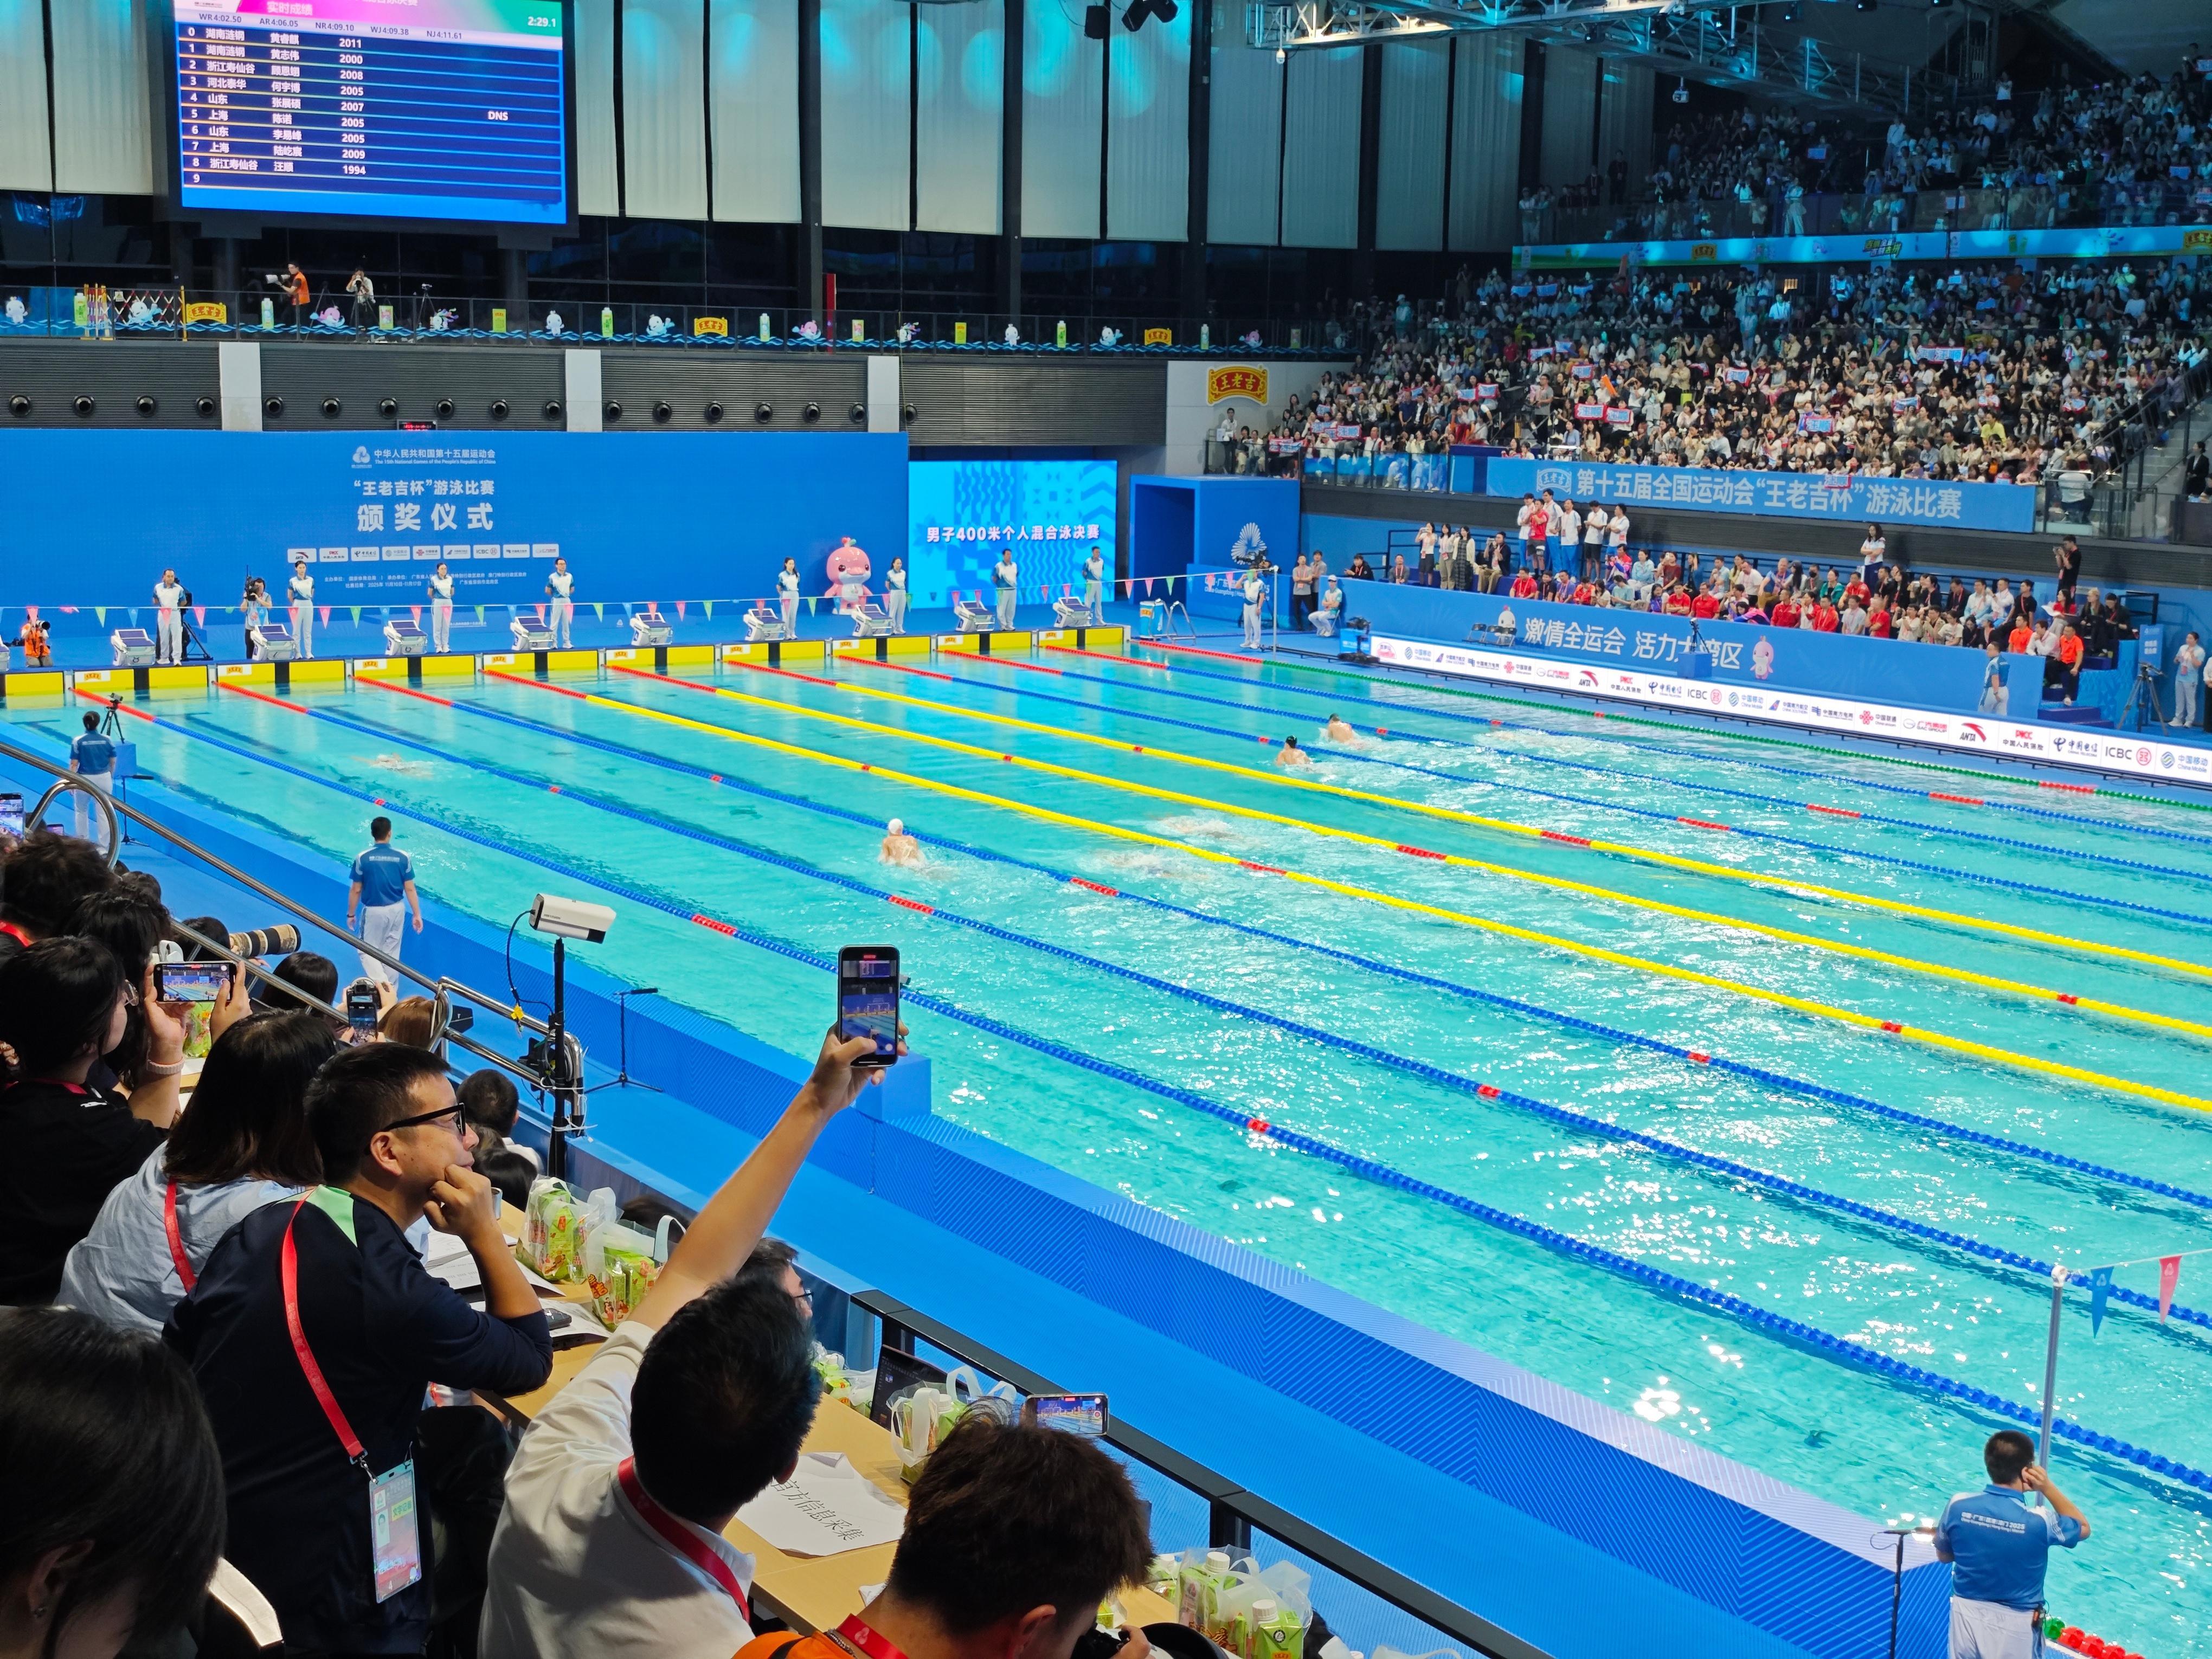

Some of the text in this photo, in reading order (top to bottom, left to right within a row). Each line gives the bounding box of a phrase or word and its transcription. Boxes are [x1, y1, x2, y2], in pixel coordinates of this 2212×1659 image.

[267, 2, 313, 16] 实时成绩
[528, 16, 556, 28] 2:29.1
[188, 28, 195, 36] 0
[206, 28, 245, 41] 湖南涟钢
[339, 38, 362, 48] 2011
[189, 44, 363, 64] 1 湖南涟钢 黄志伟 2000
[189, 60, 196, 69] 2
[207, 61, 255, 74] 浙江寿仙谷
[340, 70, 363, 80] 2008
[190, 76, 364, 96] 3 河北泰华 何宇博 2005
[190, 93, 509, 121] 4 山东 张展硕 2007 DNS
[191, 110, 198, 118] 5
[208, 110, 228, 121] 上海
[341, 118, 365, 127] 2005
[191, 126, 198, 134] 6
[209, 126, 229, 137] 山东
[342, 134, 365, 143] 2005
[192, 142, 199, 150] 7
[209, 142, 229, 153] 上海
[342, 150, 365, 159] 2009
[192, 158, 366, 175] 8 浙江寿仙谷 汪顺 1994
[194, 174, 200, 183] 9
[1221, 373, 1256, 390] 王老吉
[374, 449, 496, 459] 中华人民共和国第十五届运动会
[354, 480, 494, 496] “王老吉杯”游泳比赛
[1543, 473, 1565, 486] 王老吉
[357, 503, 493, 532] 颁奖仪式
[927, 524, 1099, 543] 男子400米个人混合泳决赛
[1525, 617, 1626, 655] 激情全运会
[1579, 679, 1591, 687] ANTA
[1687, 689, 1707, 699] ICBC
[1959, 732, 1976, 742] ANTA
[2105, 746, 2132, 760] ICBC
[2178, 754, 2208, 767] 中国移动
